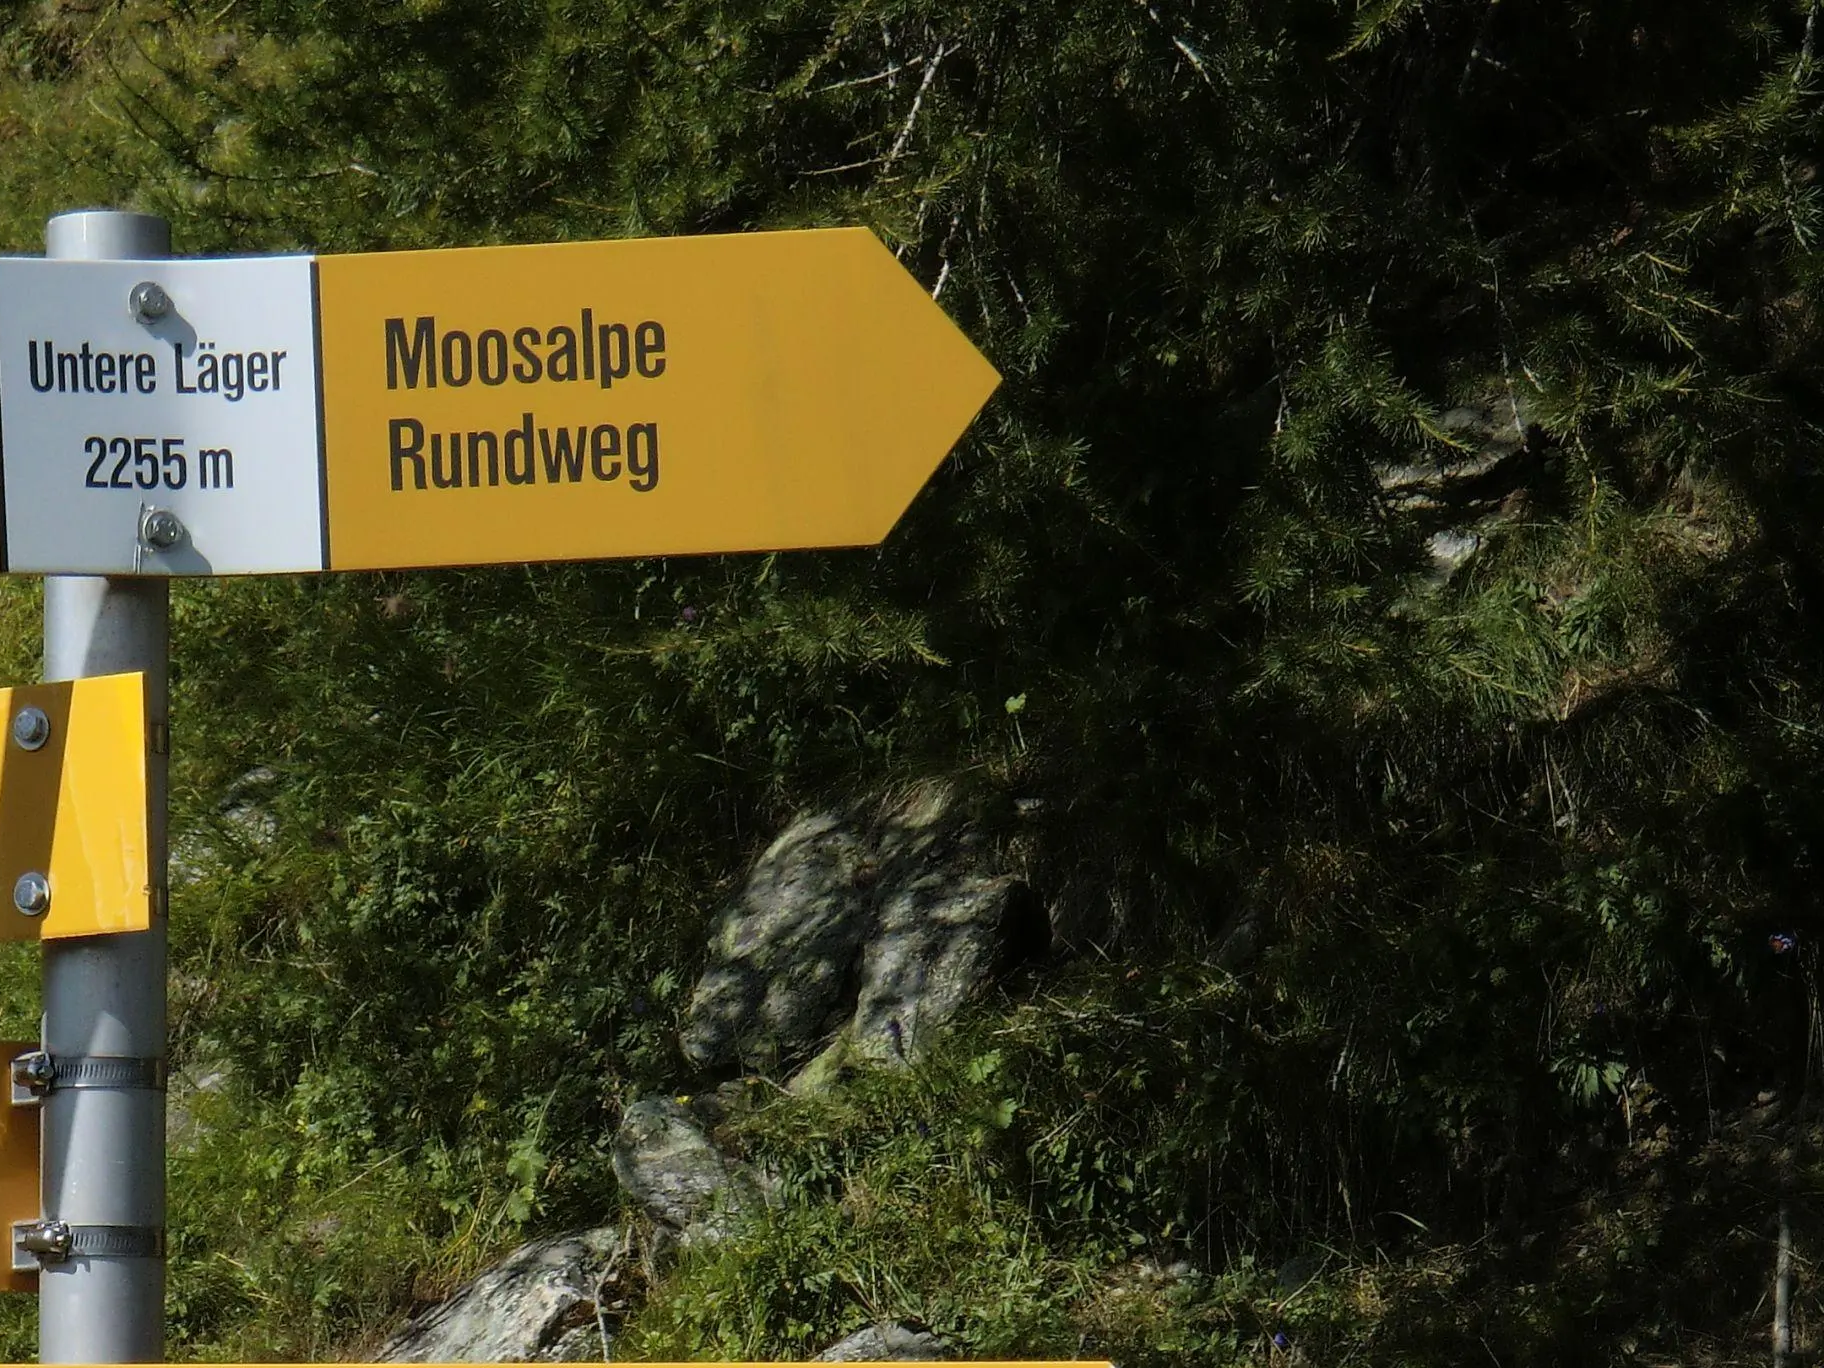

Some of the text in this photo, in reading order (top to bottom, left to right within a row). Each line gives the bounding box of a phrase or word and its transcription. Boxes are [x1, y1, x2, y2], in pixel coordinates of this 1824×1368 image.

[28, 339, 287, 401] Untere Läger
[385, 308, 667, 391] Moosalpe
[84, 436, 233, 489] 2255 m
[389, 412, 659, 492] Rundweg
